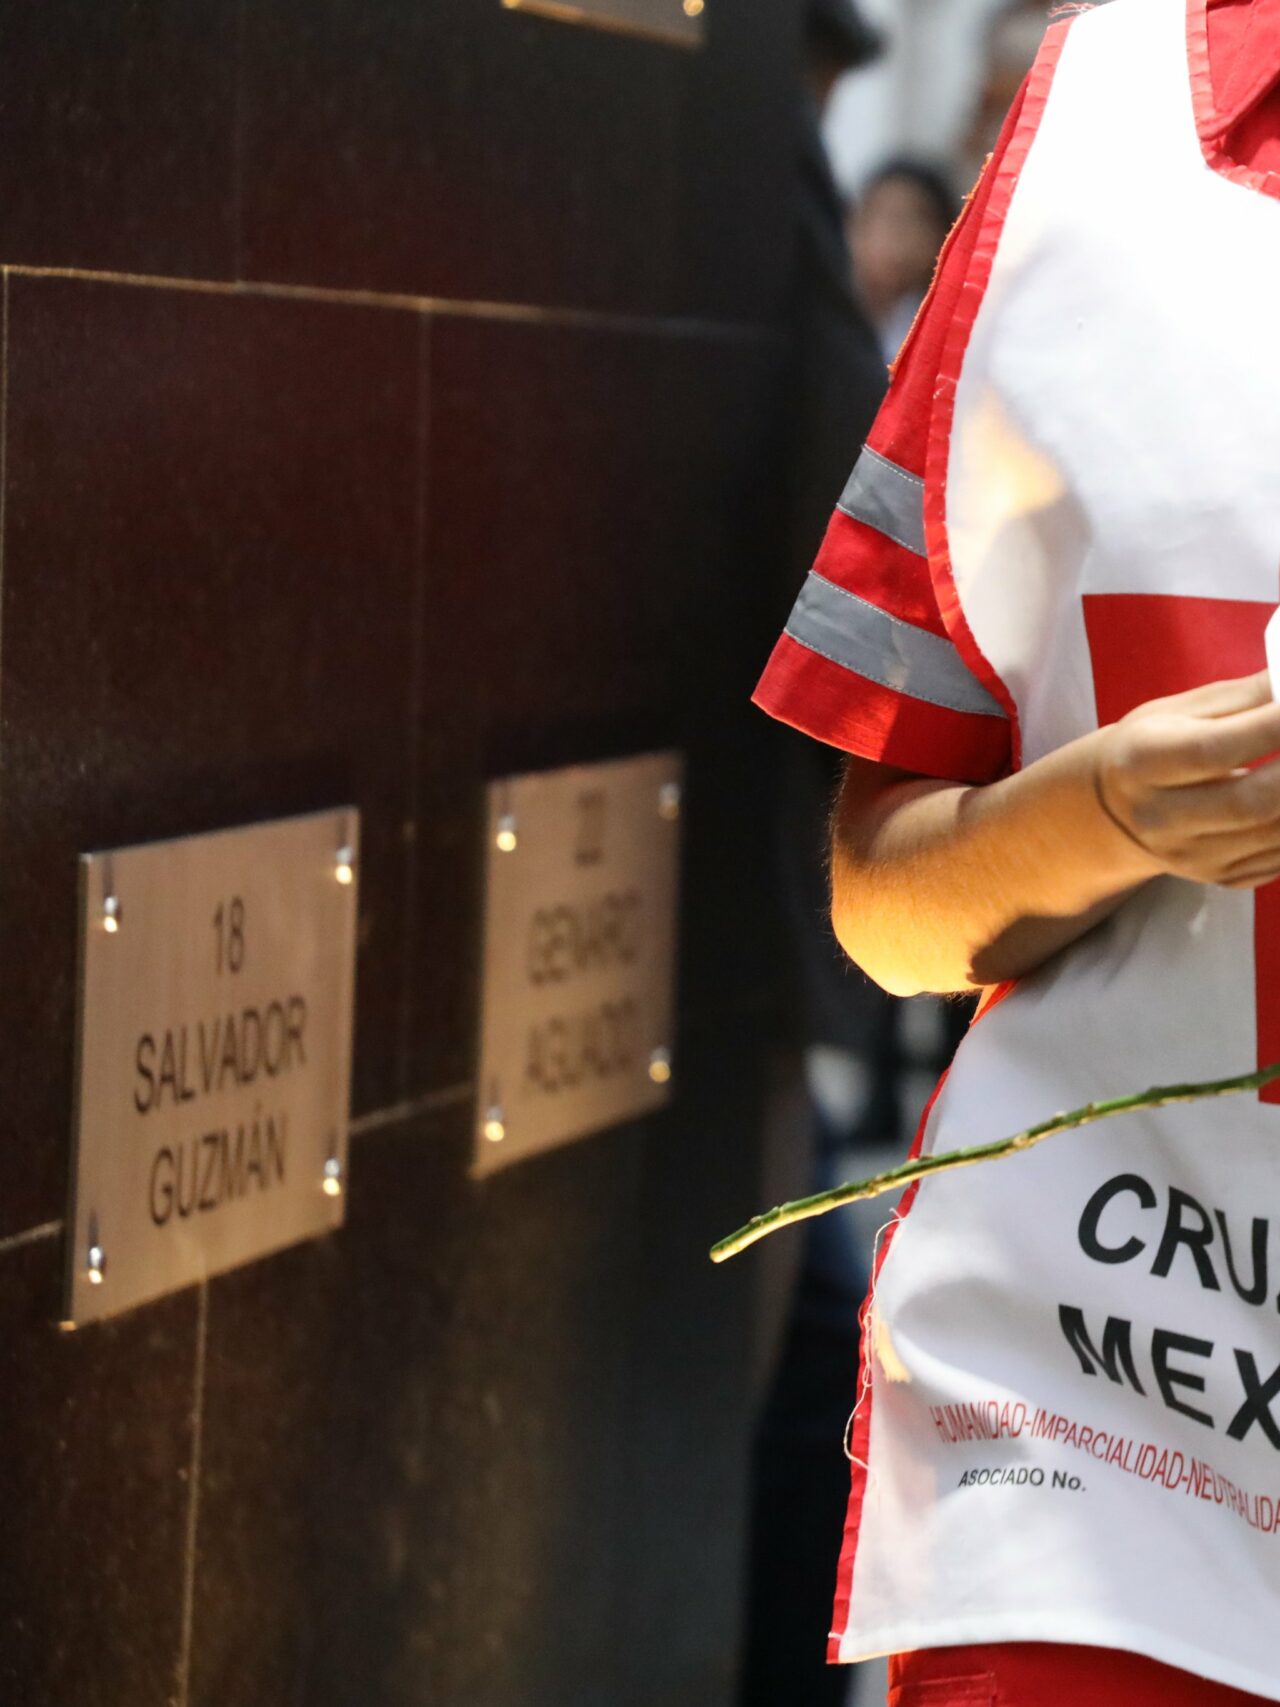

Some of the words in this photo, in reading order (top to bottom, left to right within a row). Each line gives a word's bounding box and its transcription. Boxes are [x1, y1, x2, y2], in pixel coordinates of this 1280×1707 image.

[213, 896, 244, 976] 18
[134, 996, 307, 1115] SALVADOR
[149, 1101, 288, 1228] GUZMÁN
[957, 1467, 1045, 1490] ASOCIADO
[1051, 1470, 1087, 1492] No.
